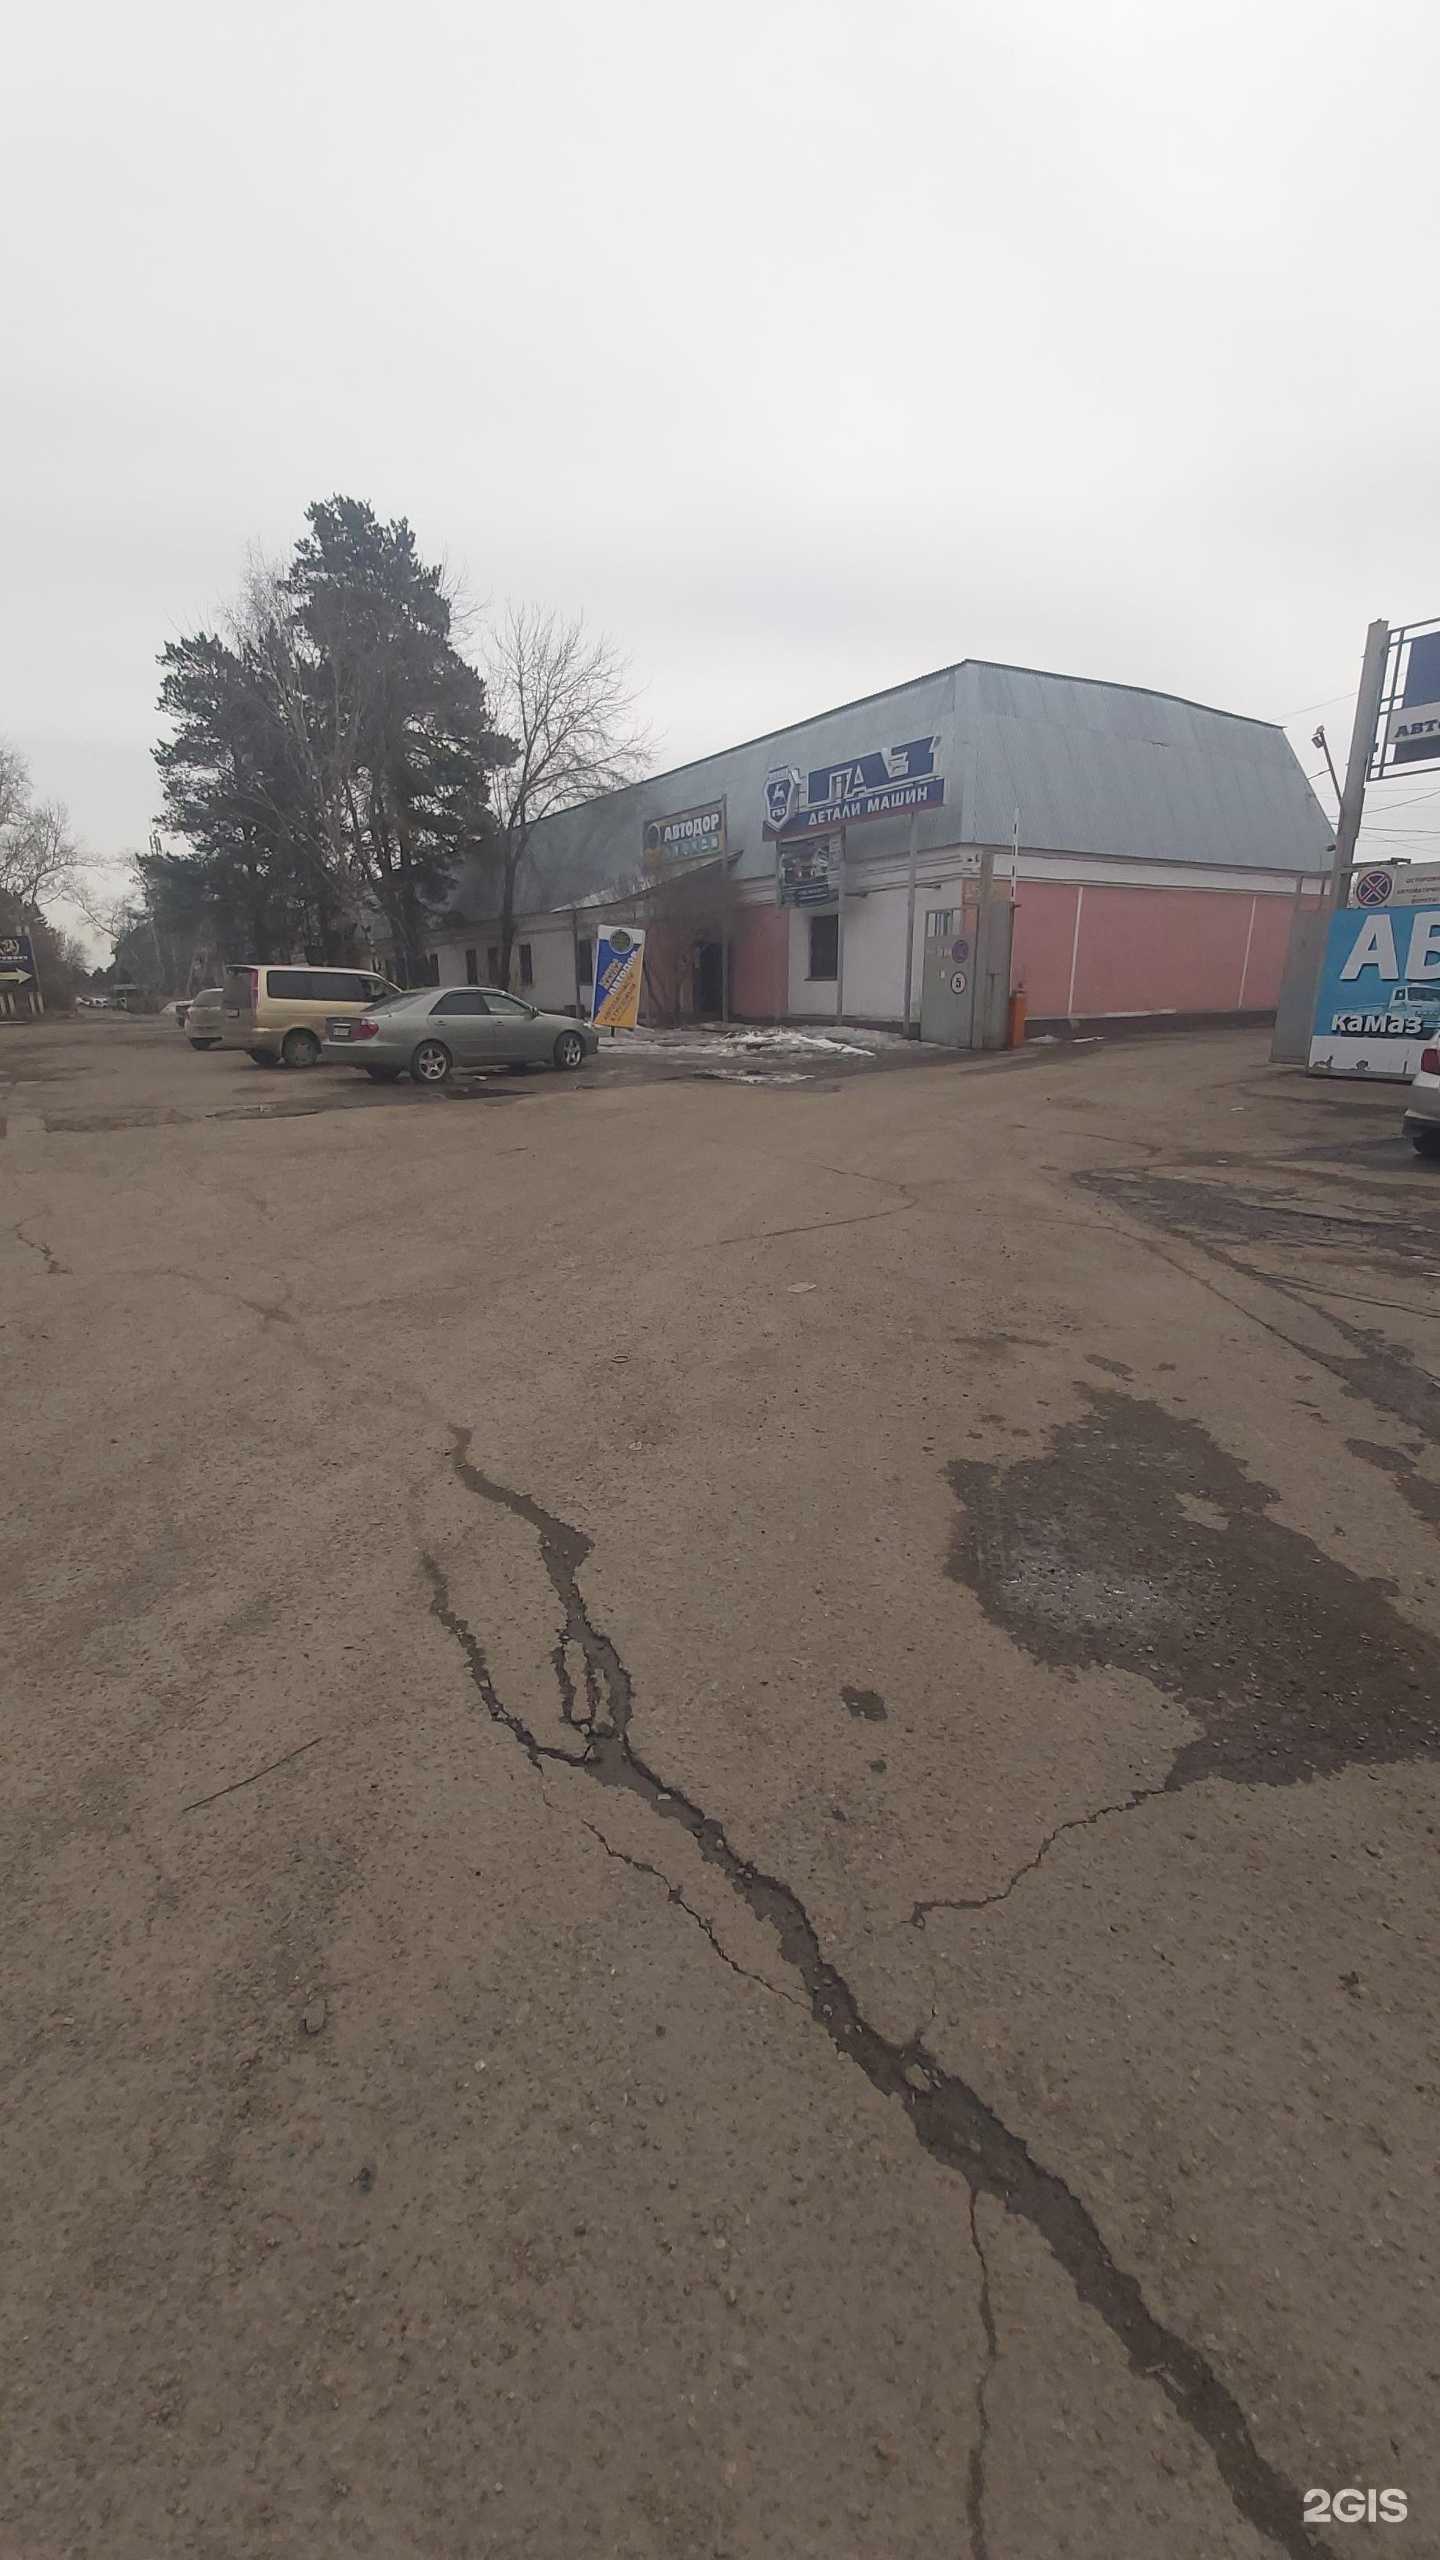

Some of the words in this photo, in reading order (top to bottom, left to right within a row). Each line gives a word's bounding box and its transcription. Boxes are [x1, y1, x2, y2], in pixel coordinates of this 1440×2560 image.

[1394, 719, 1440, 738] АВТ
[808, 802, 861, 825] ДЕТАЛИ
[867, 786, 928, 812] МАШИН
[664, 813, 719, 842] АВТОДОР
